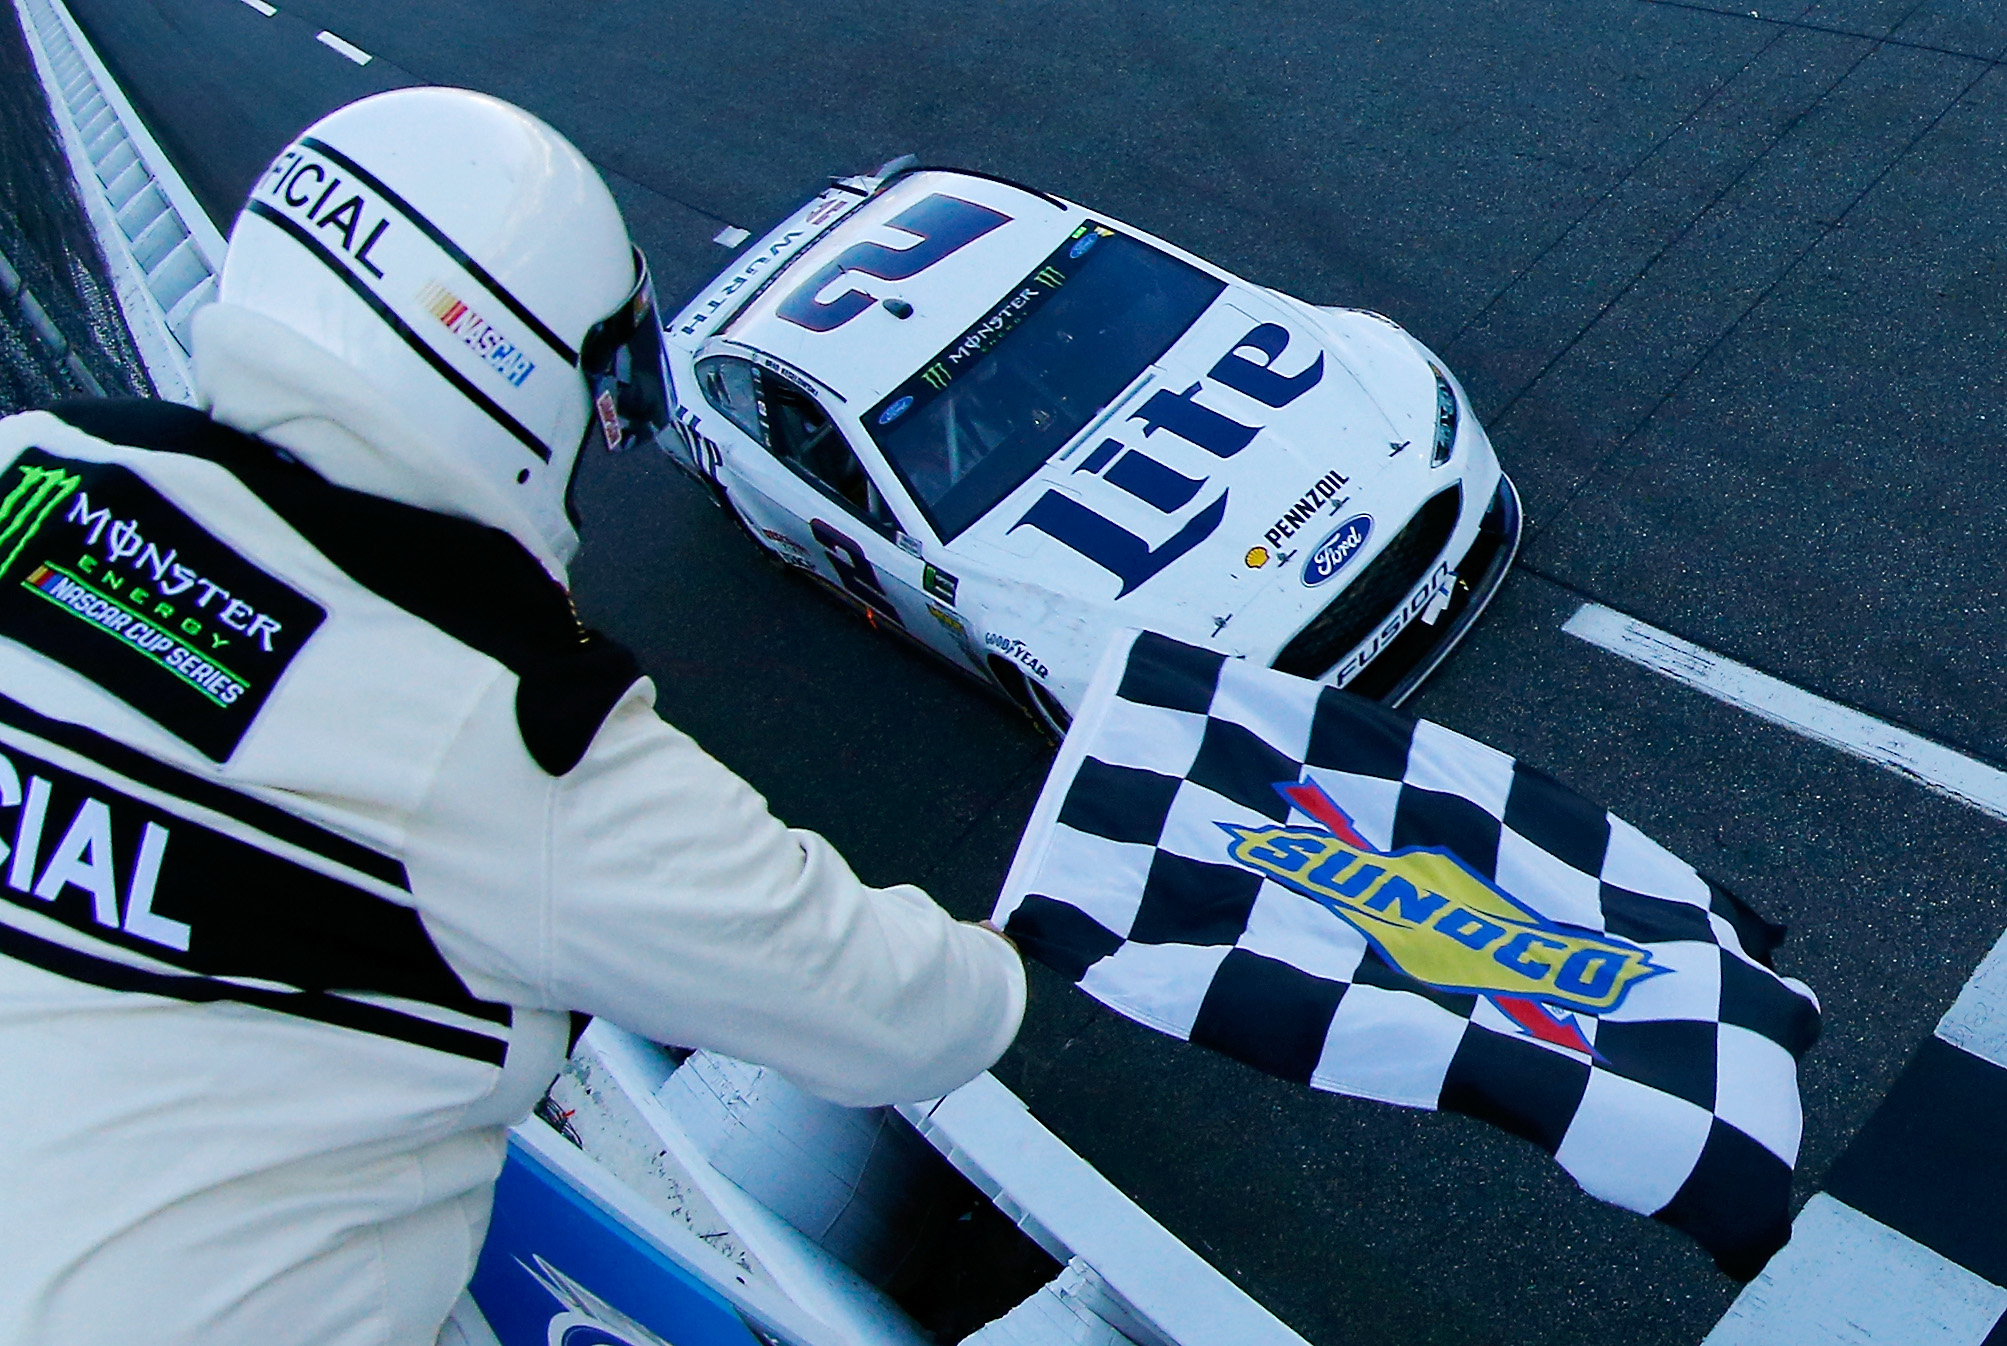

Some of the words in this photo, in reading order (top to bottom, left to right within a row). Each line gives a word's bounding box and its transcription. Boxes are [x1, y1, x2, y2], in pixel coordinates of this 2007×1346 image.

[776, 192, 1014, 333] 2
[948, 287, 1040, 364] MONSTER
[446, 308, 537, 388] NASCAR
[1006, 323, 1325, 601] Lite
[1264, 469, 1350, 549] PENNZOIL
[66, 491, 283, 653] MONSTER
[76, 553, 230, 650] ENERGY
[1313, 526, 1362, 577] Ford
[50, 576, 131, 639] NASCAR
[123, 620, 174, 655] CUP
[164, 645, 245, 706] SERIES
[1336, 560, 1450, 687] FUSION
[1247, 835, 1629, 999] SUNOCO
